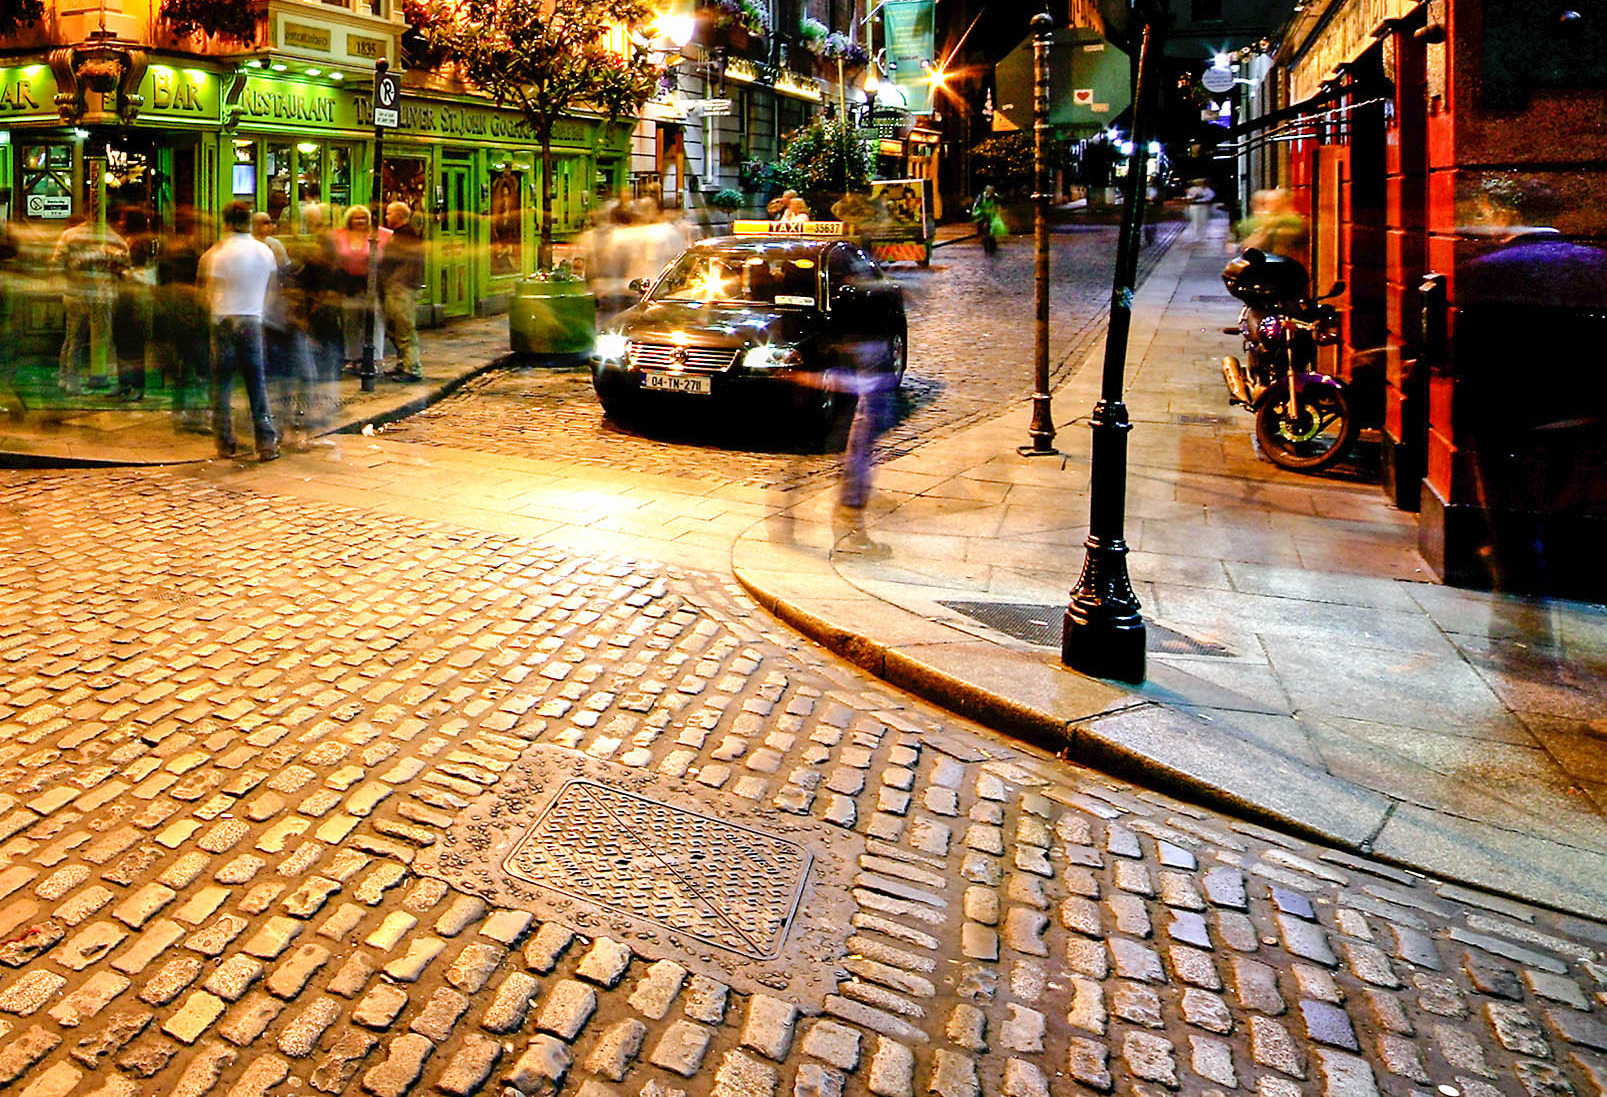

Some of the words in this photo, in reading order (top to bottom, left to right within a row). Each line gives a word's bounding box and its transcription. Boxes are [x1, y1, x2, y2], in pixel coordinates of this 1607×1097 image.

[151, 72, 204, 112] BAR
[240, 87, 337, 124] RESTAURANT
[398, 103, 437, 132] LIVER
[770, 222, 804, 233] TAXI
